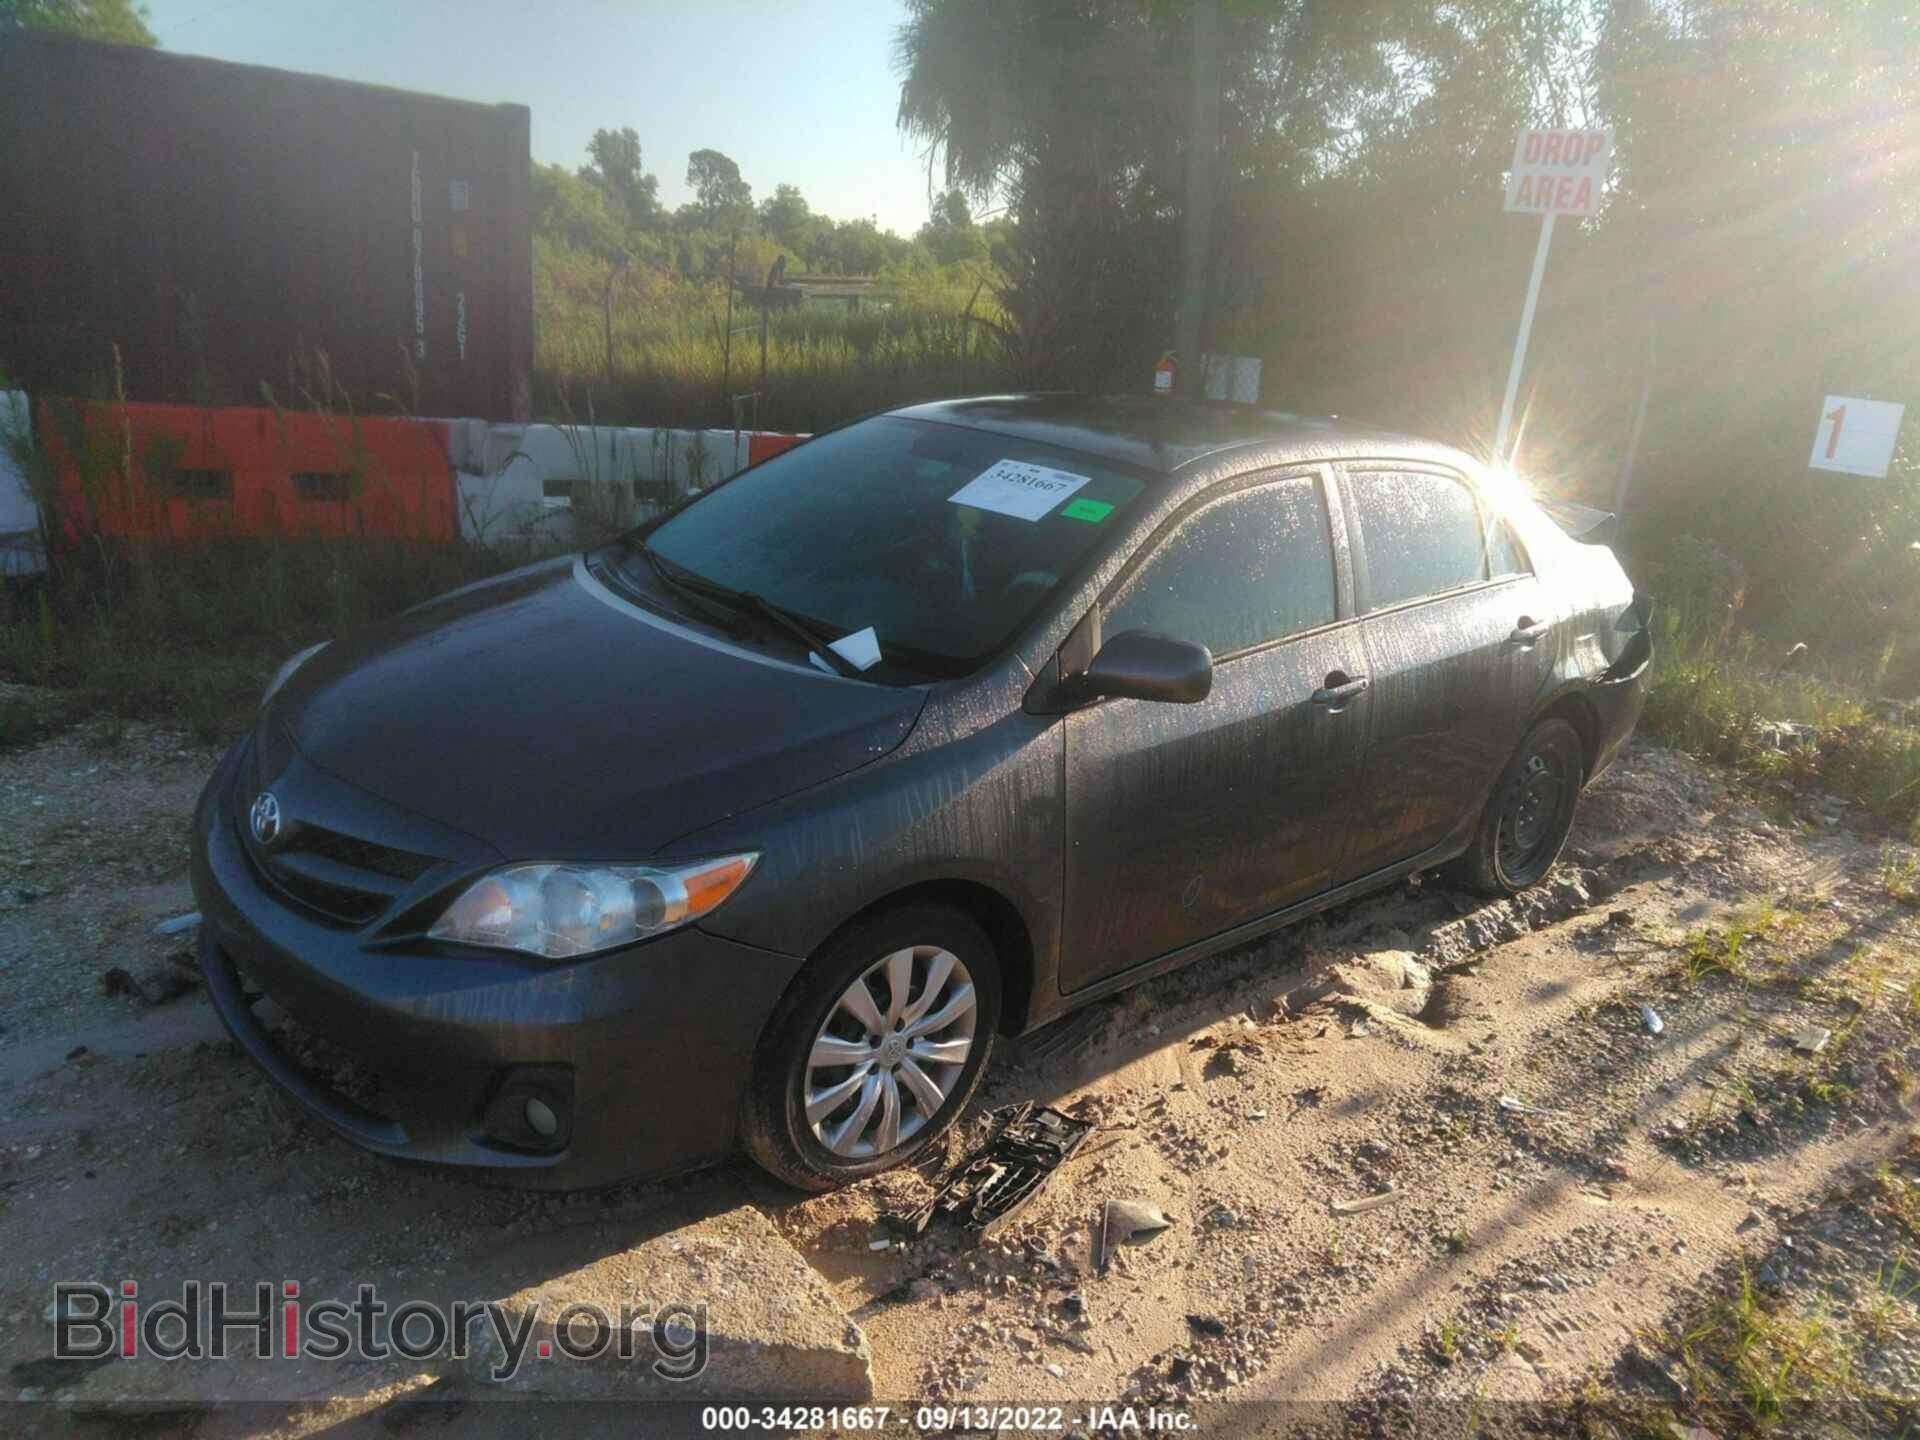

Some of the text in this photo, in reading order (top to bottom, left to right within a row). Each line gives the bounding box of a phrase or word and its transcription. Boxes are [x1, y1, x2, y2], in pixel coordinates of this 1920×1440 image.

[1522, 131, 1605, 167] DROP
[1514, 174, 1594, 210] AREA
[1824, 403, 1847, 460] 1
[990, 469, 1068, 493] 34281667
